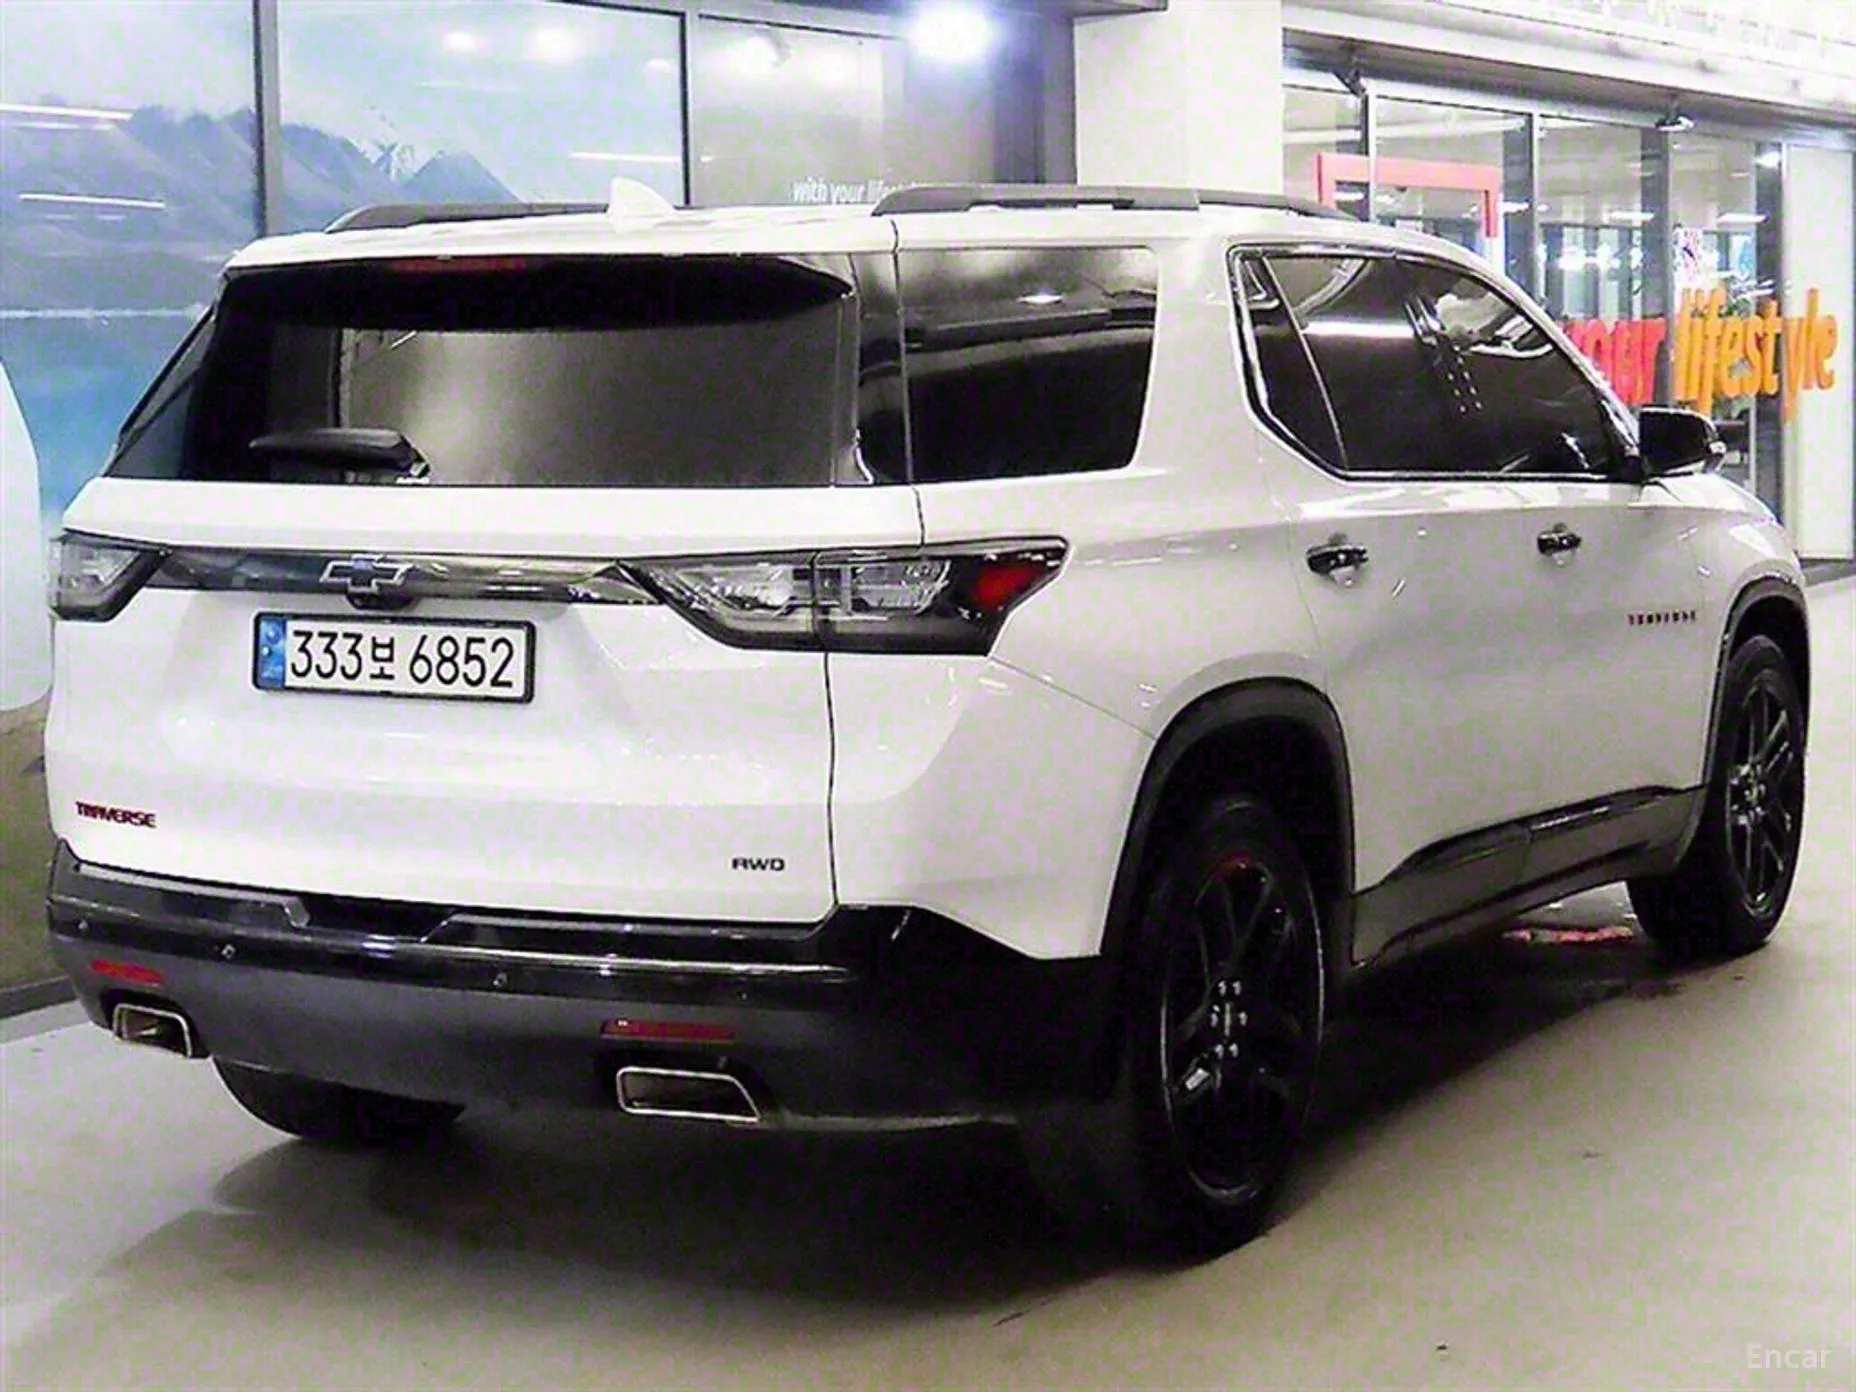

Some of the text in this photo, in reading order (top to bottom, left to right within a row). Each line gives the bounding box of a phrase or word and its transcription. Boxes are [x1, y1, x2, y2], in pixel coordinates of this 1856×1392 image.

[792, 177, 829, 202] with
[831, 182, 865, 205] your
[1673, 287, 1838, 428] lifestyle
[290, 629, 515, 688] 333보 6852
